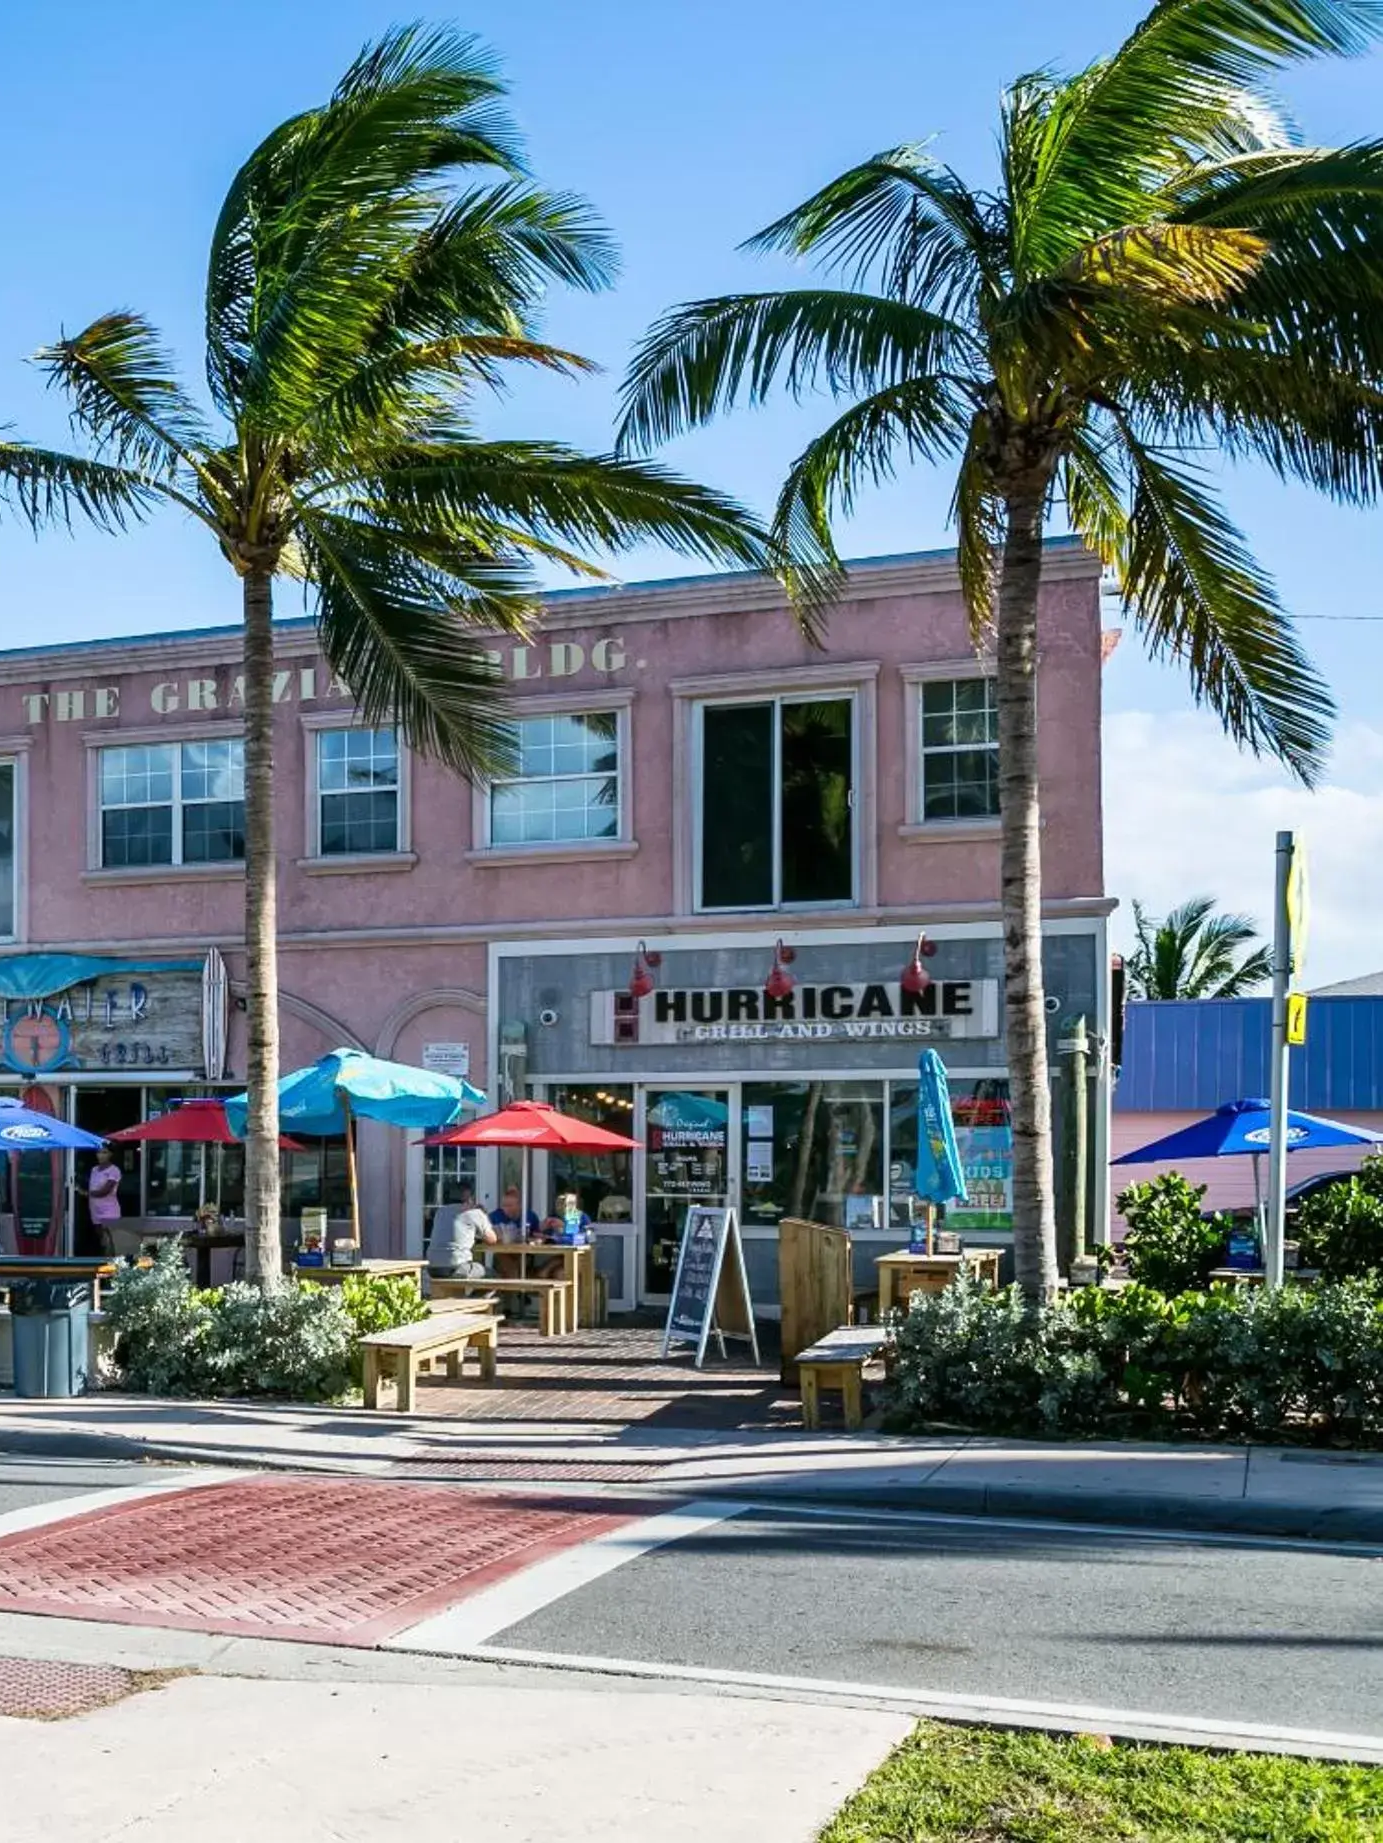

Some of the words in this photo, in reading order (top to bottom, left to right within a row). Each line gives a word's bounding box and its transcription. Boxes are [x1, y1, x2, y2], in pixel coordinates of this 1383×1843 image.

[23, 686, 119, 725] THE
[655, 981, 973, 1023] HURRICANE
[694, 1023, 768, 1040] GRILL
[779, 1021, 833, 1038] AND
[842, 1019, 931, 1037] WINGS
[662, 1131, 724, 1142] HURRICANE
